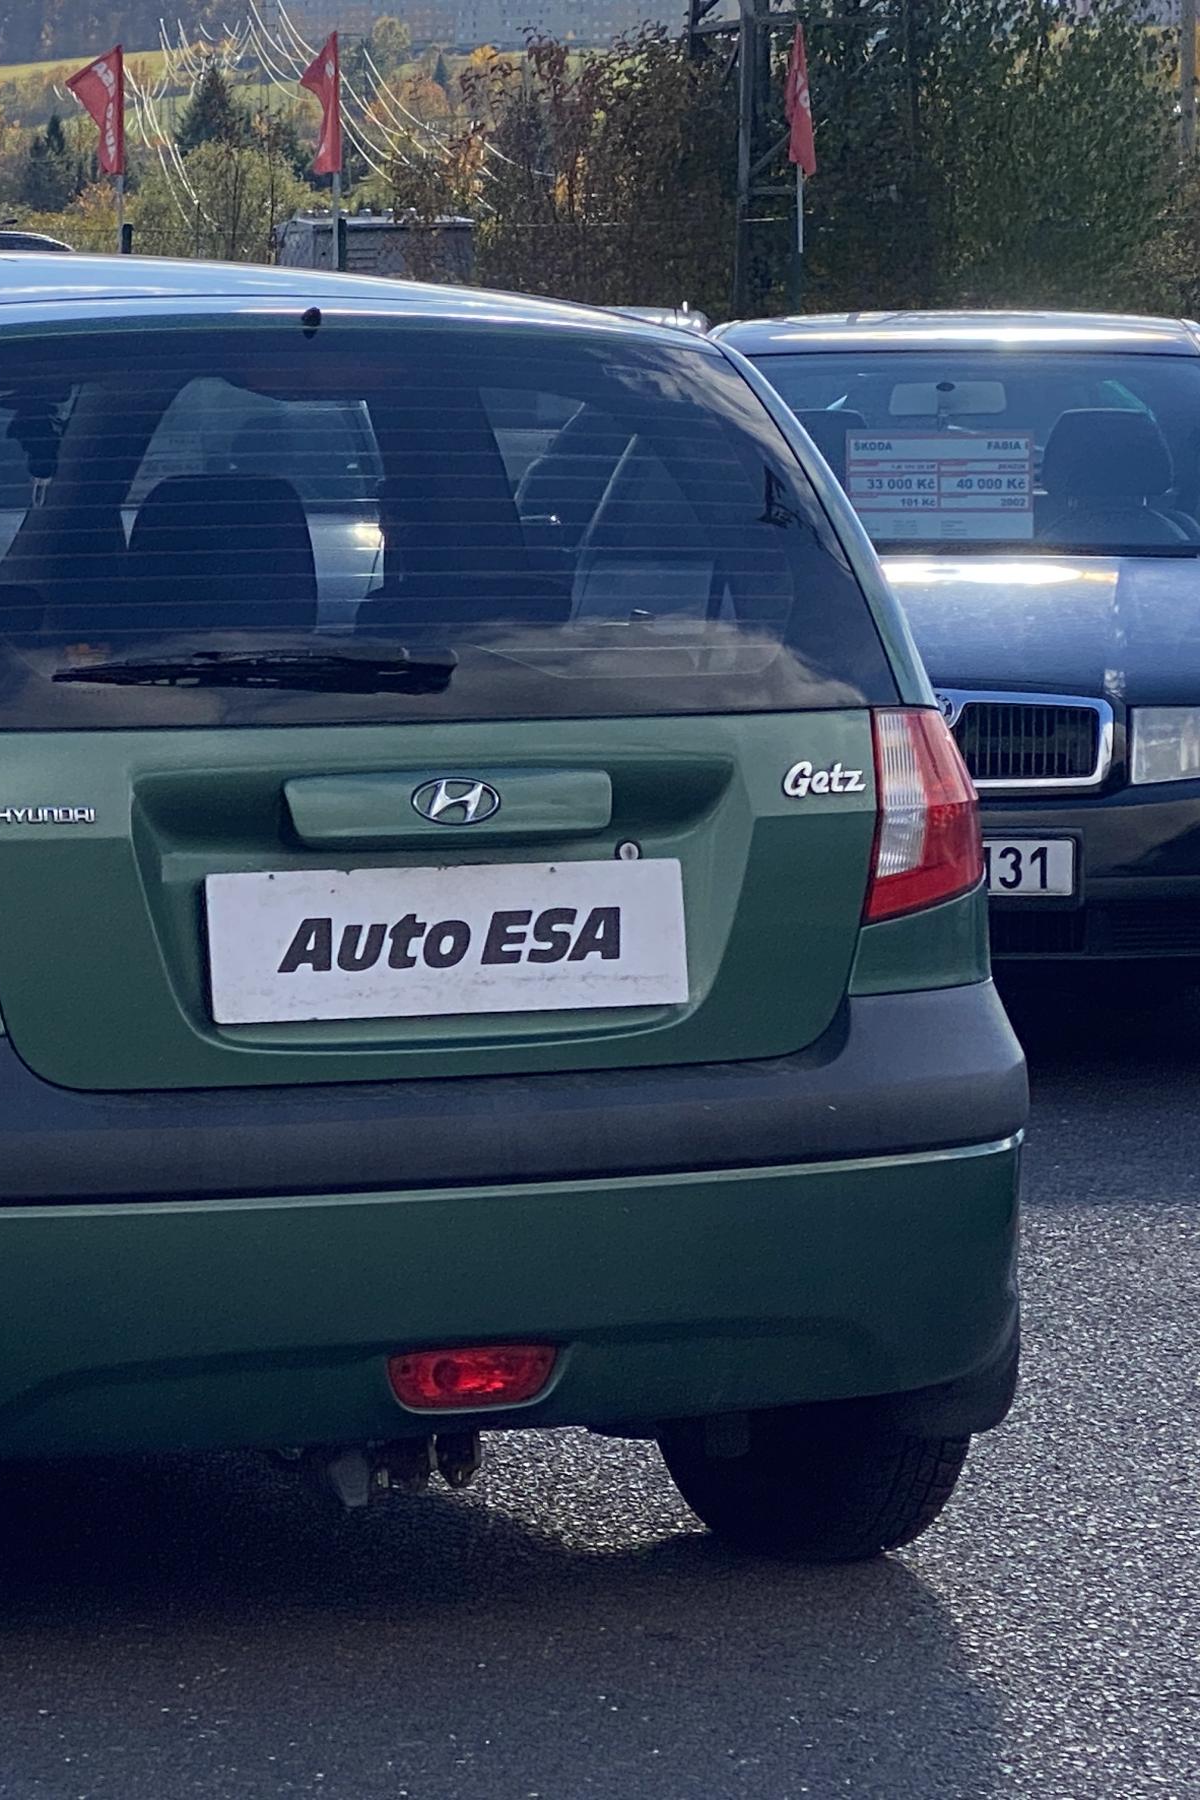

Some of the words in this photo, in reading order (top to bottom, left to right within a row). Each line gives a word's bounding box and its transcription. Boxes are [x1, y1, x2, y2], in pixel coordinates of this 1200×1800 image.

[987, 441, 1022, 451] FABIA
[867, 478, 883, 489] 33
[887, 478, 912, 489] 000
[917, 478, 936, 489] Kč
[956, 478, 973, 489] 40
[977, 478, 1003, 489] 000
[1007, 478, 1026, 489] Kč
[784, 761, 866, 797] Getz
[277, 914, 471, 973] Auto
[480, 907, 620, 965] ESA
